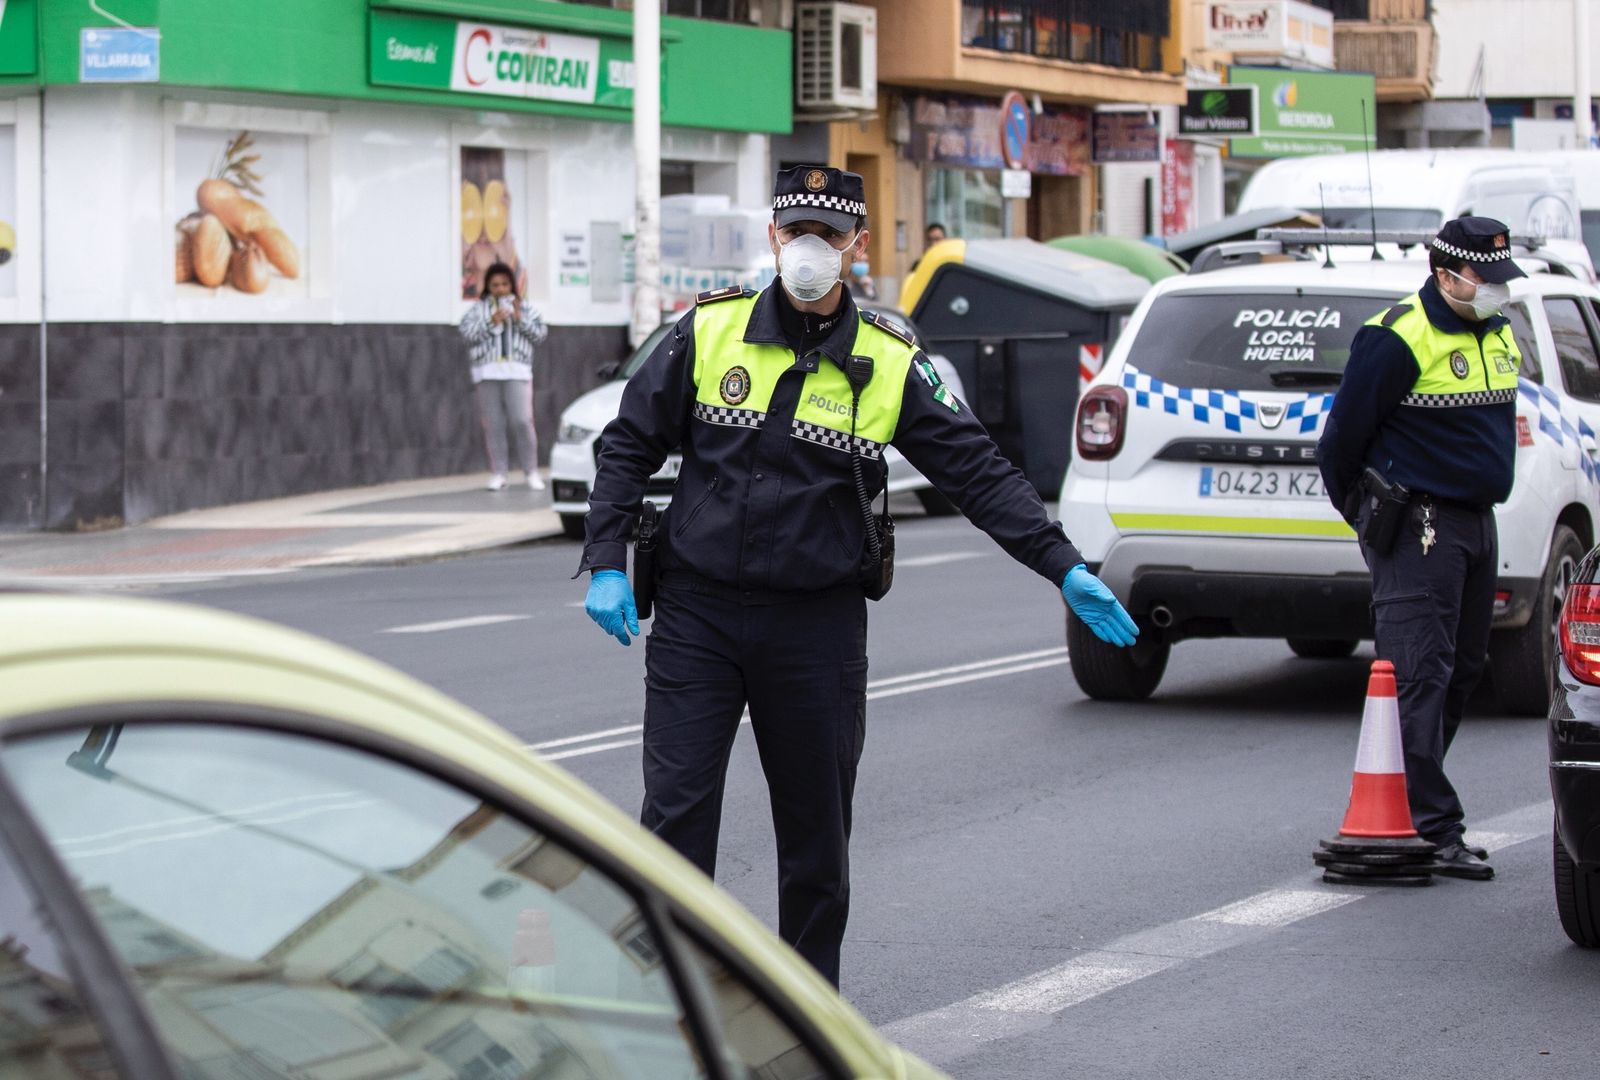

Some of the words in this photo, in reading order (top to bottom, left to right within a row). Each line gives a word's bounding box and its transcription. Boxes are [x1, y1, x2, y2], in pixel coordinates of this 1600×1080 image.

[496, 50, 590, 89] COVIRAN
[1278, 111, 1334, 128] IBERDROLA
[1233, 306, 1341, 328] POLICÍA
[1243, 347, 1315, 361] HUELVA
[1196, 444, 1317, 458] DUSTE
[1217, 471, 1279, 495] 0423
